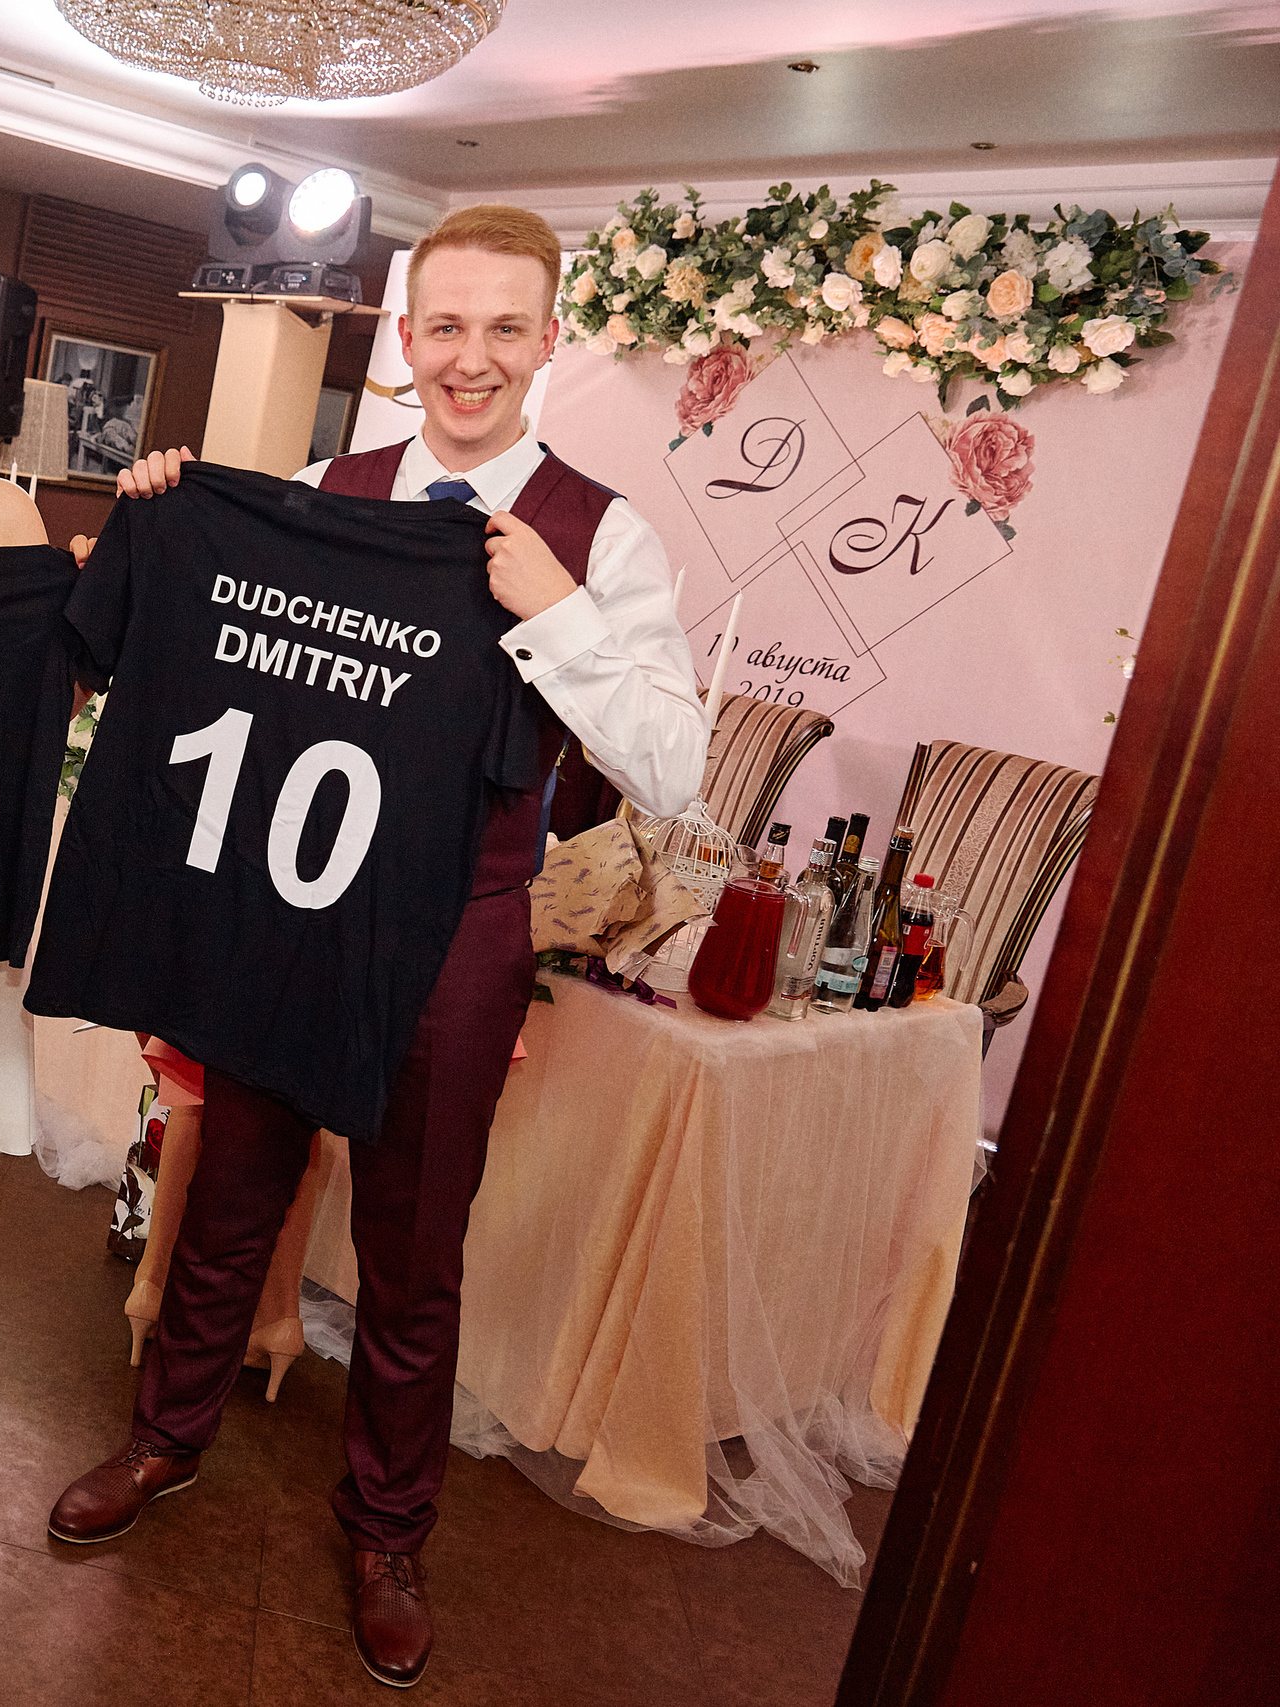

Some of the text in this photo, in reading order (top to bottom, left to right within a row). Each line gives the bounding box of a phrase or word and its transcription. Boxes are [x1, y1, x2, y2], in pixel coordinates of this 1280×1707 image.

[210, 573, 442, 658] DUDCHENKO
[214, 623, 412, 708] DMITRIY
[746, 641, 851, 684] августа
[168, 707, 382, 910] 10
